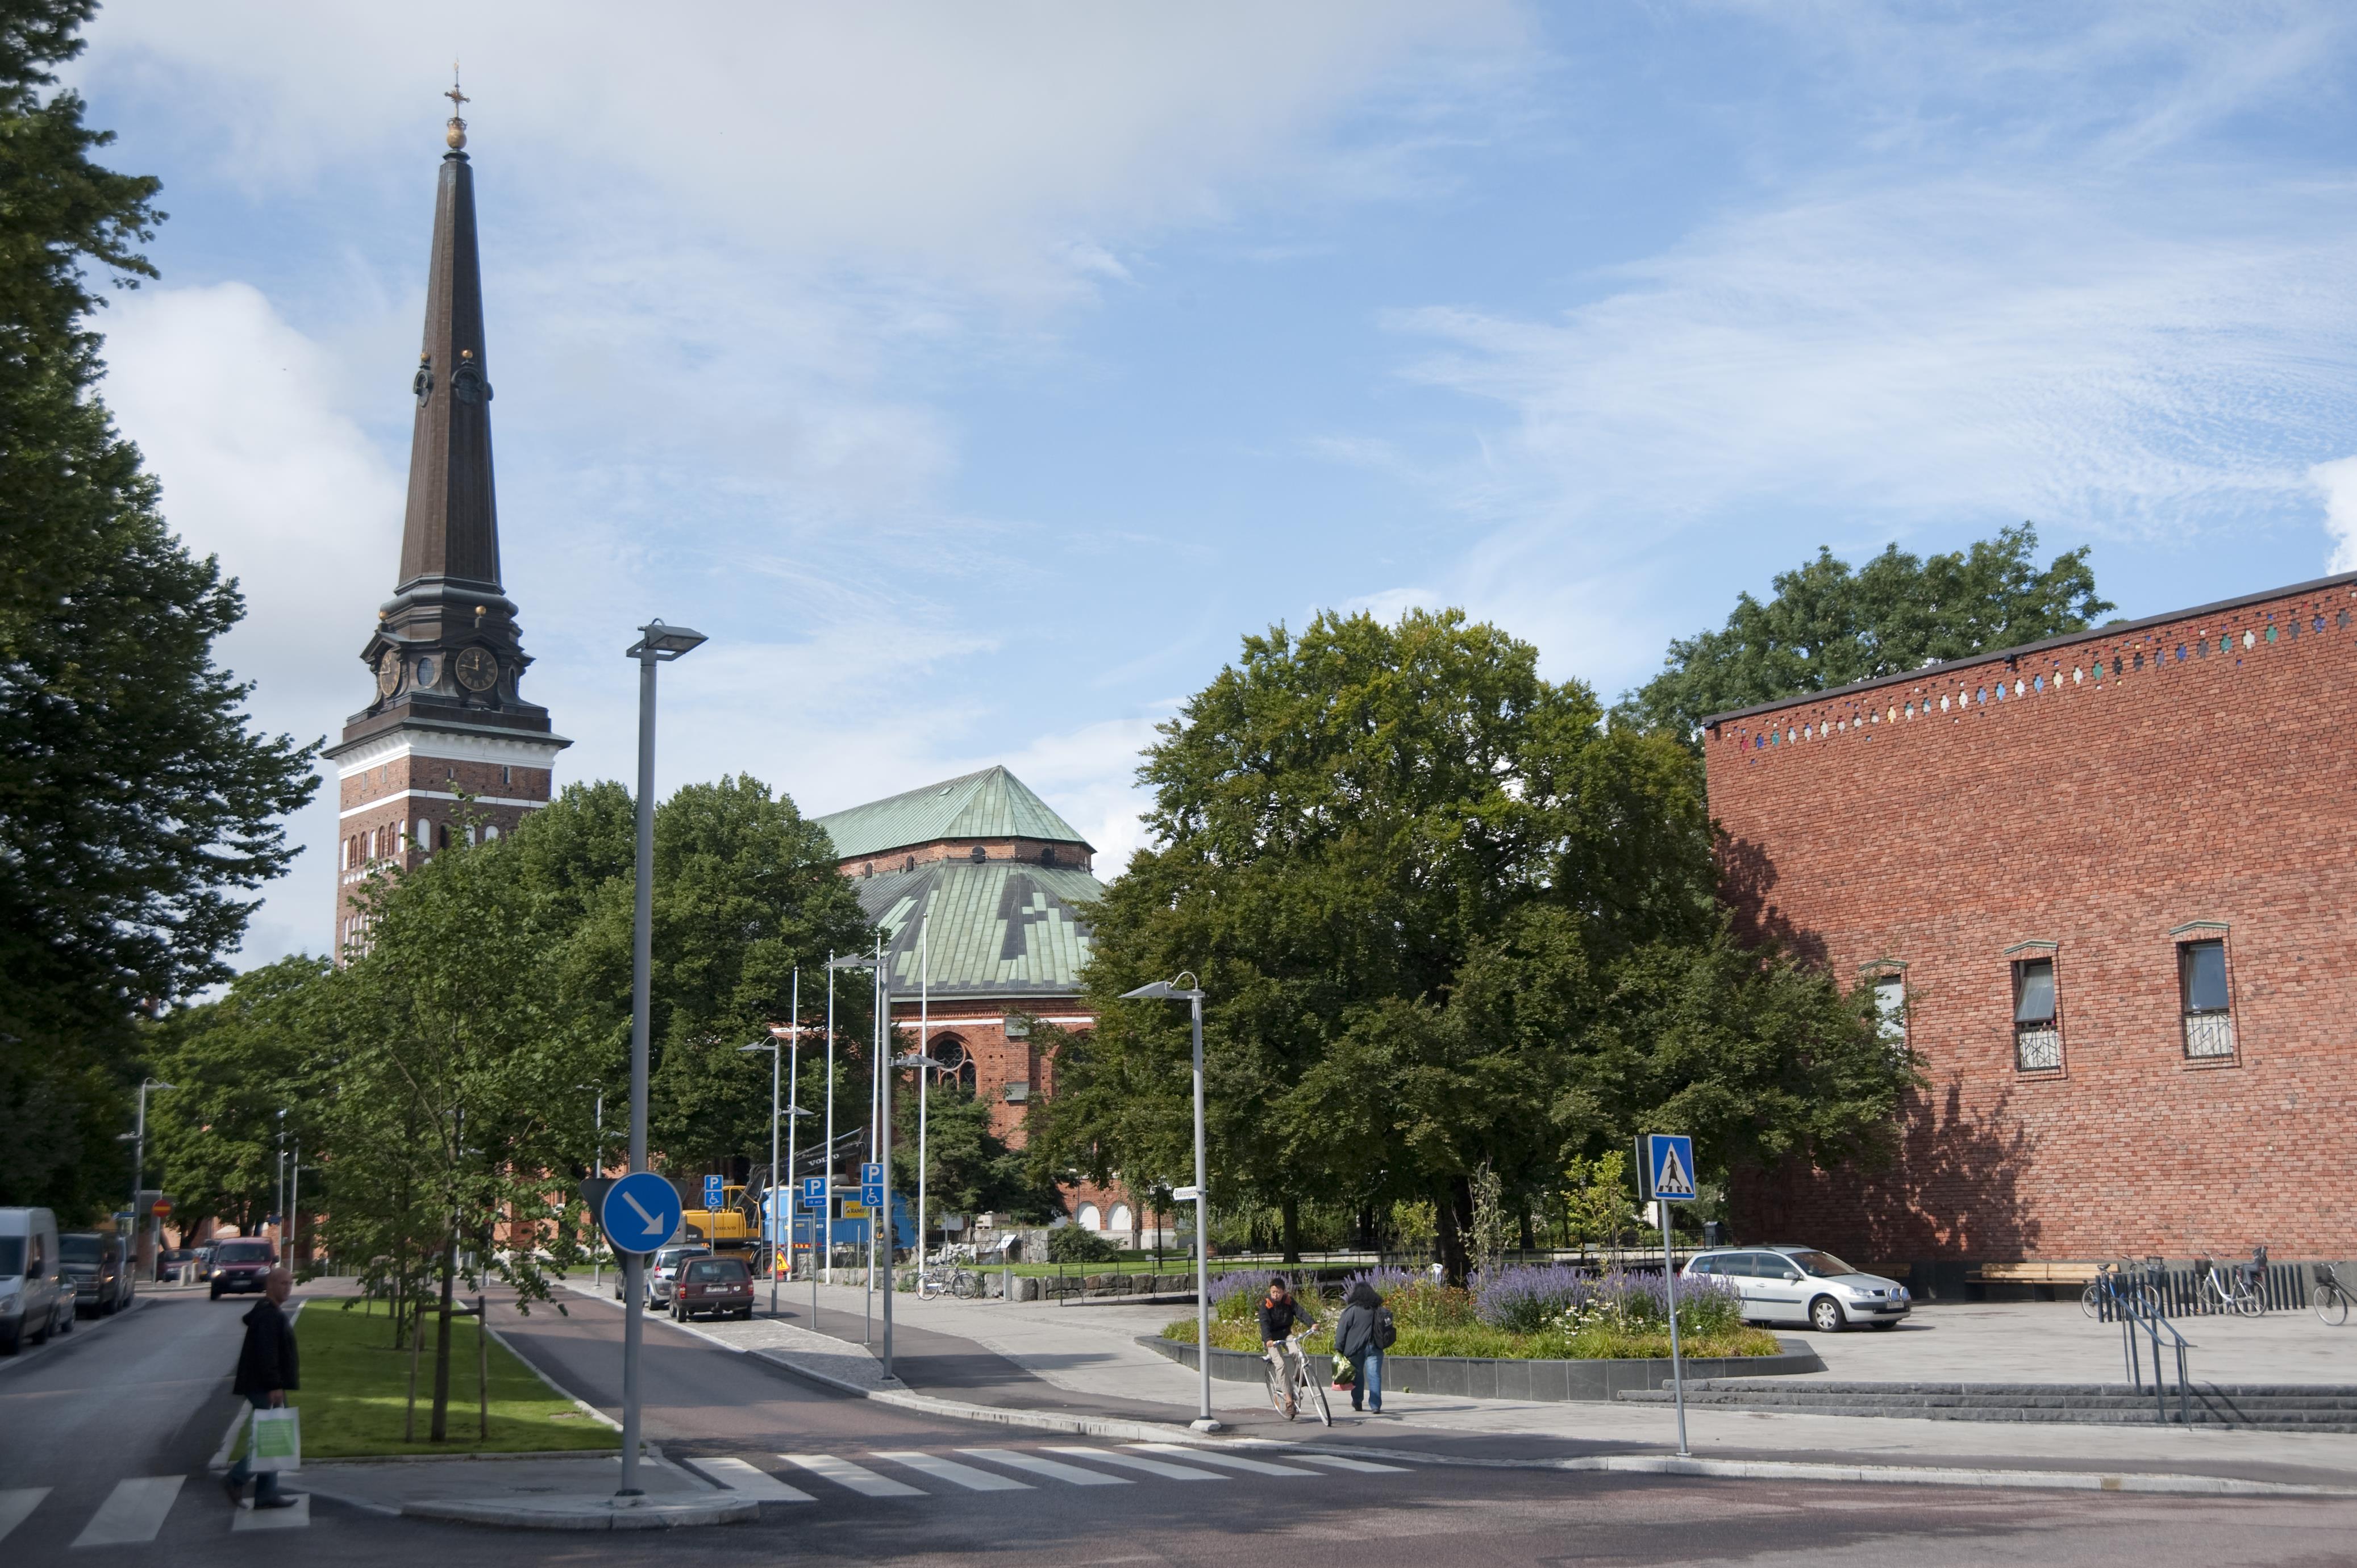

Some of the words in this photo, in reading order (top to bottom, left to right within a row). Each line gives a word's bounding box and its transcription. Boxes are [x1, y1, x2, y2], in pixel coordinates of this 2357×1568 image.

[807, 1154, 839, 1166] VOLO
[869, 1166, 880, 1182] P
[710, 1177, 719, 1189] P
[811, 1180, 821, 1195] P
